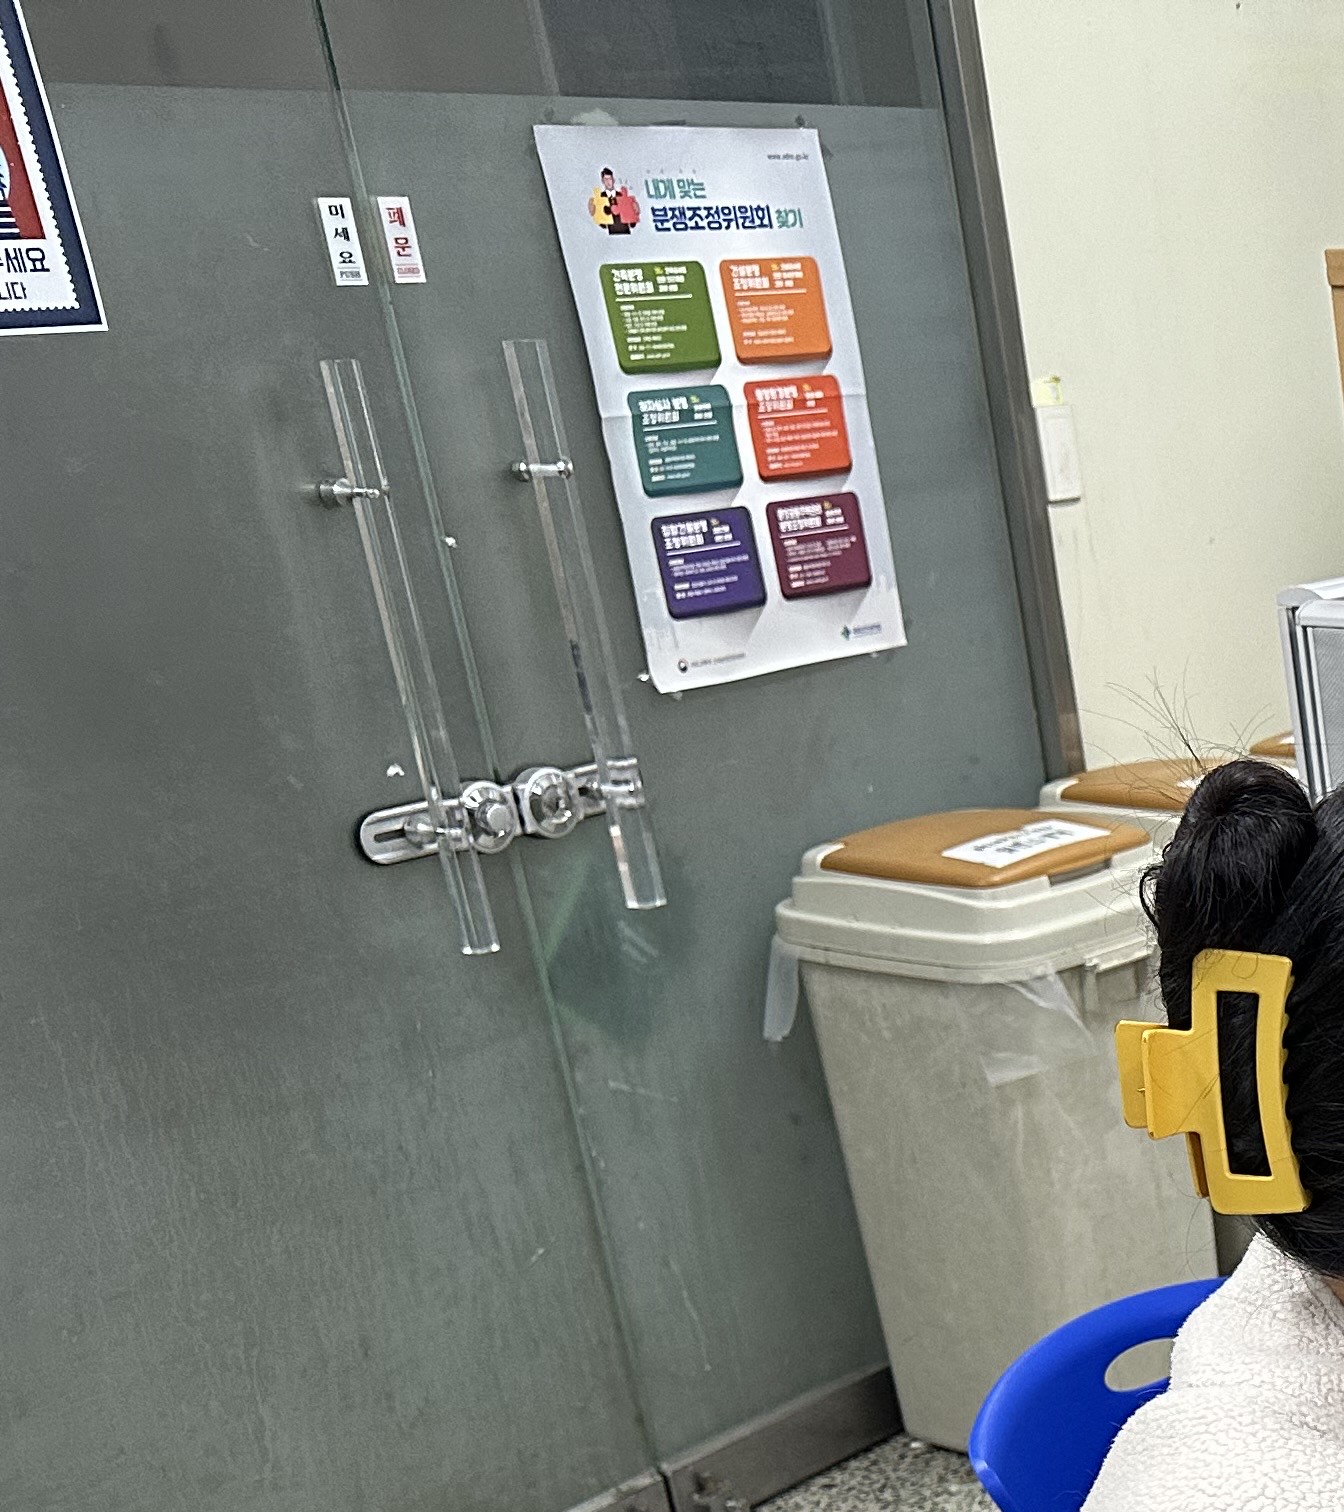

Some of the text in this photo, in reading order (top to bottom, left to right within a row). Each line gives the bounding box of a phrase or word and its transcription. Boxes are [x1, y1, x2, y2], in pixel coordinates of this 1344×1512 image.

[328, 203, 356, 264] 미세요
[385, 206, 413, 257] 폐문
[651, 204, 804, 232] 분쟁조정위원회 찾기
